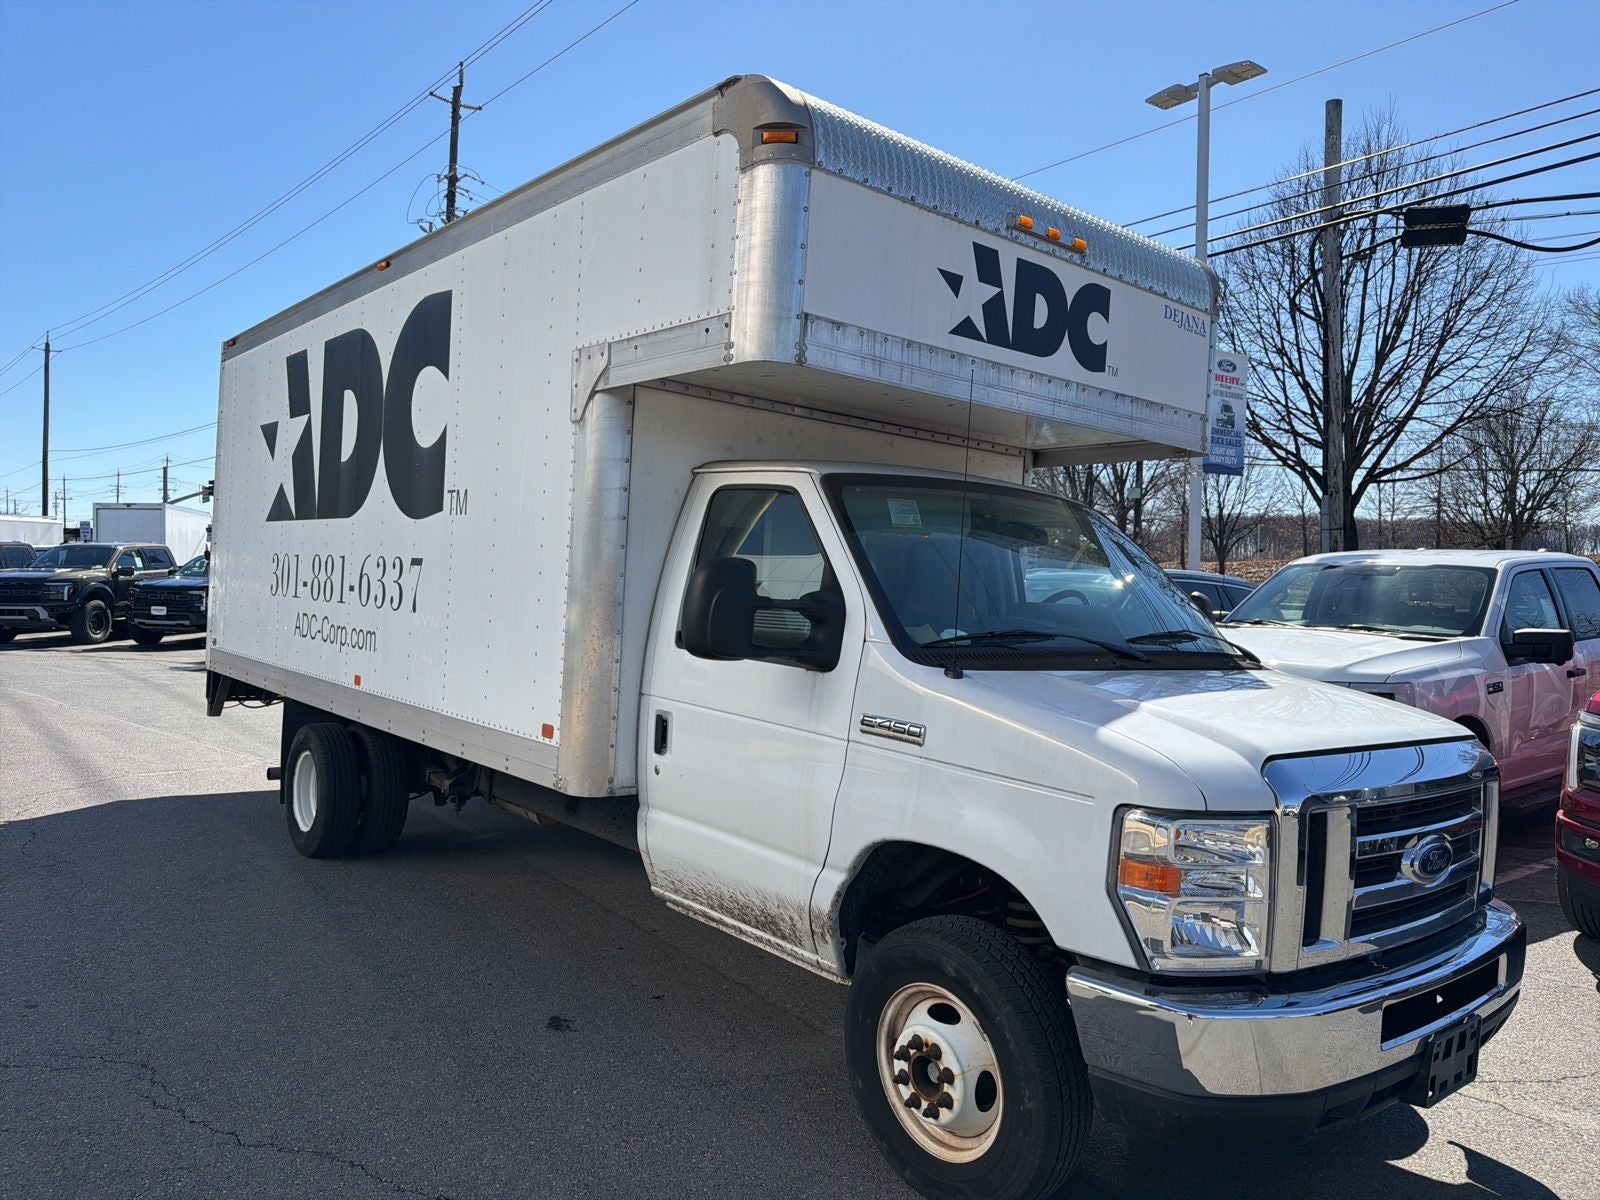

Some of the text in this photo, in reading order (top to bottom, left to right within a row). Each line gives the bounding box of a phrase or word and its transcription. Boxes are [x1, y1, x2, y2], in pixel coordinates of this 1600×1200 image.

[937, 241, 1111, 373] ADC
[1163, 304, 1207, 334] DEJANA
[1215, 373, 1240, 385] HEEHY
[260, 289, 468, 522] ADC TM
[1211, 427, 1242, 439] OMMERCIAL
[1211, 436, 1242, 448] RUCK SALES
[1209, 455, 1238, 465] HEAVY DUTY
[1226, 448, 1236, 456] AND
[270, 552, 424, 614] 301-881-6337
[293, 611, 378, 653] ADC-Corp.com
[1427, 850, 1448, 871] Ford
